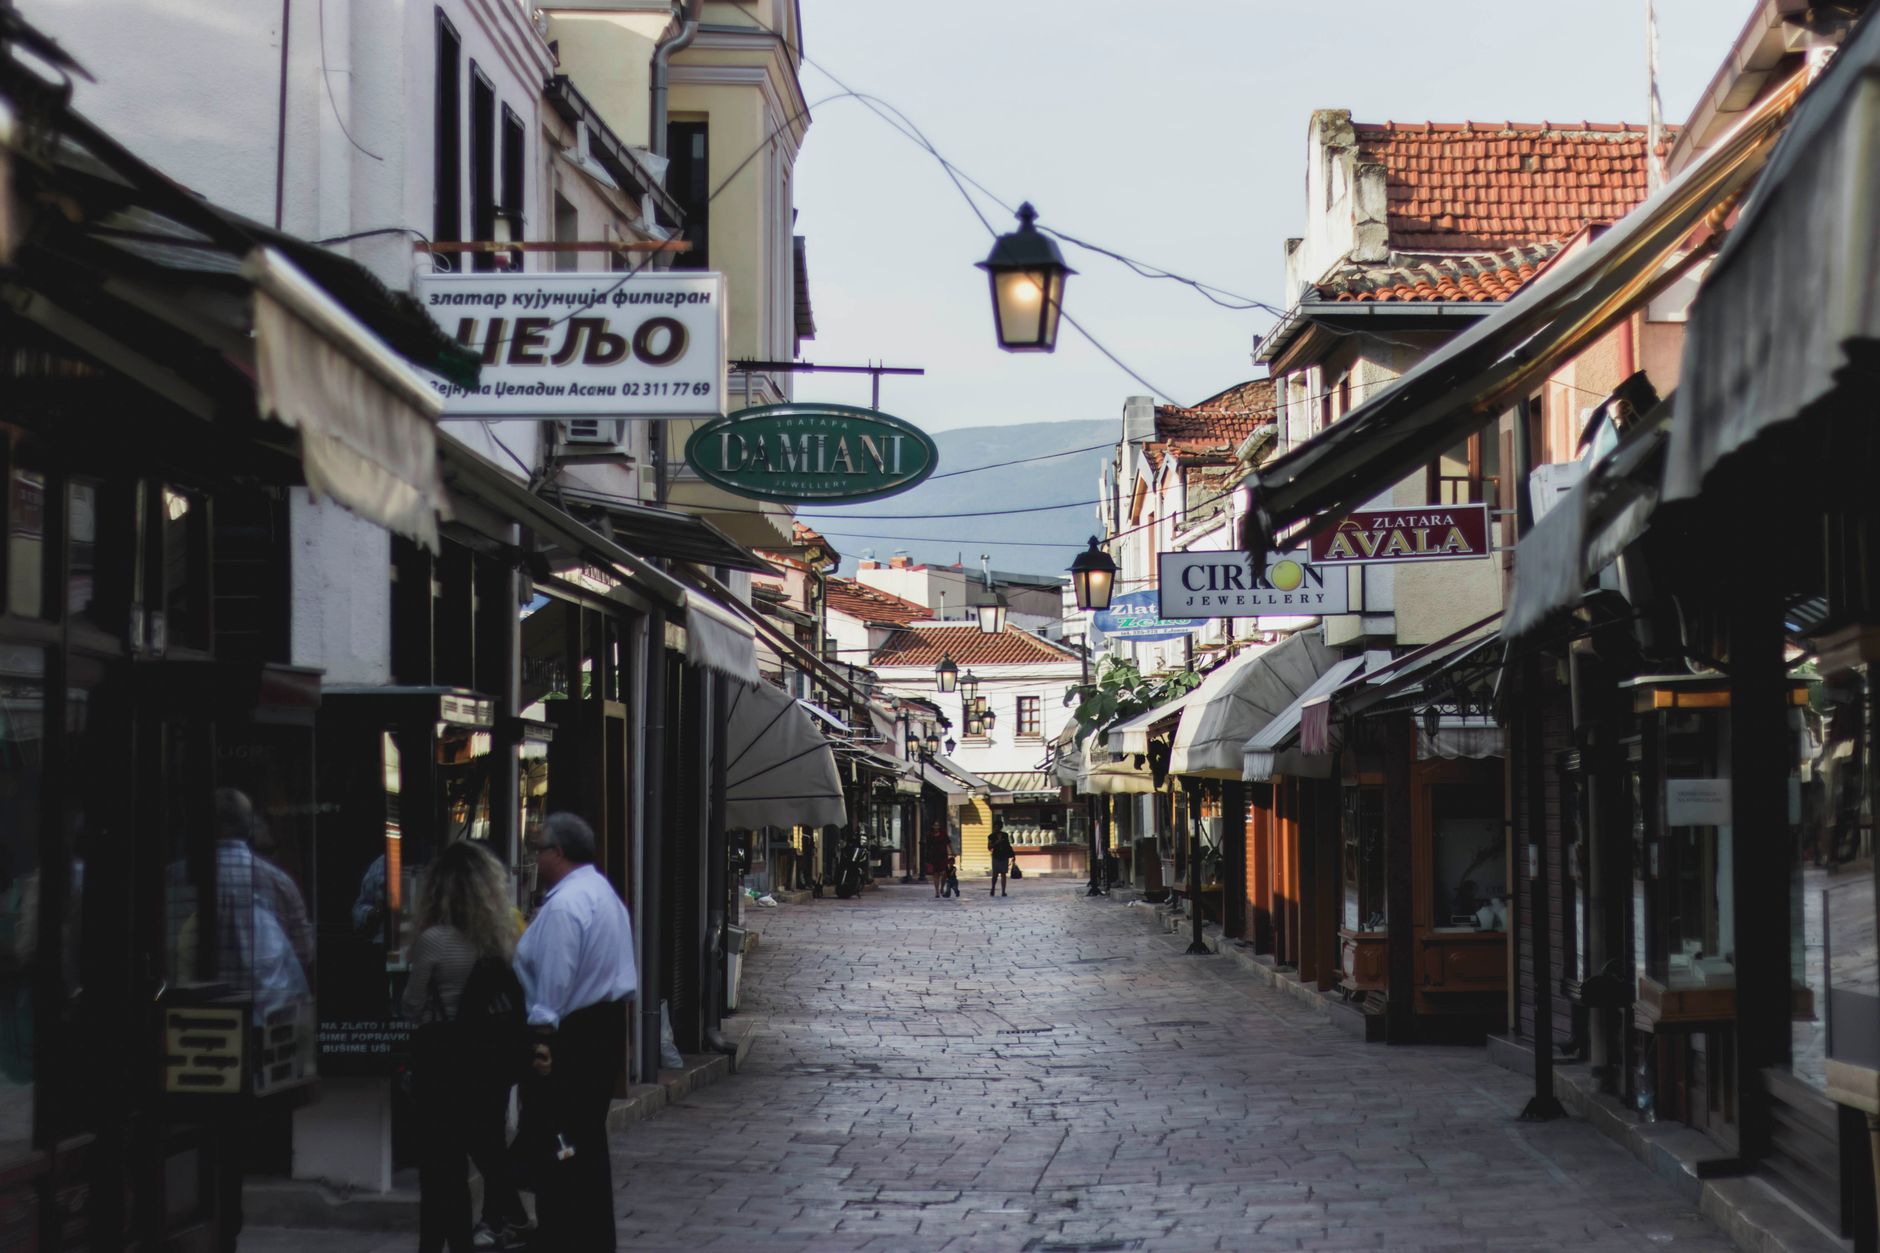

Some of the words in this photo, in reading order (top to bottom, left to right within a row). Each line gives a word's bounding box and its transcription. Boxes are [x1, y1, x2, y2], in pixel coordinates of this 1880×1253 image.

[429, 292, 507, 309] златар
[612, 288, 711, 309] филигран
[568, 382, 616, 396] Асани
[622, 382, 639, 396] 02
[642, 382, 668, 396] 311
[672, 382, 690, 396] 77
[692, 382, 711, 396] 69
[717, 431, 905, 475] DAMIANI
[1372, 514, 1455, 529] ZLATARA
[1324, 526, 1473, 559] AVALA
[1186, 594, 1325, 606] JEWELLERY
[321, 1022, 338, 1030] NA
[340, 1022, 378, 1030] ZLATO
[351, 1033, 411, 1041] POPRAVKI
